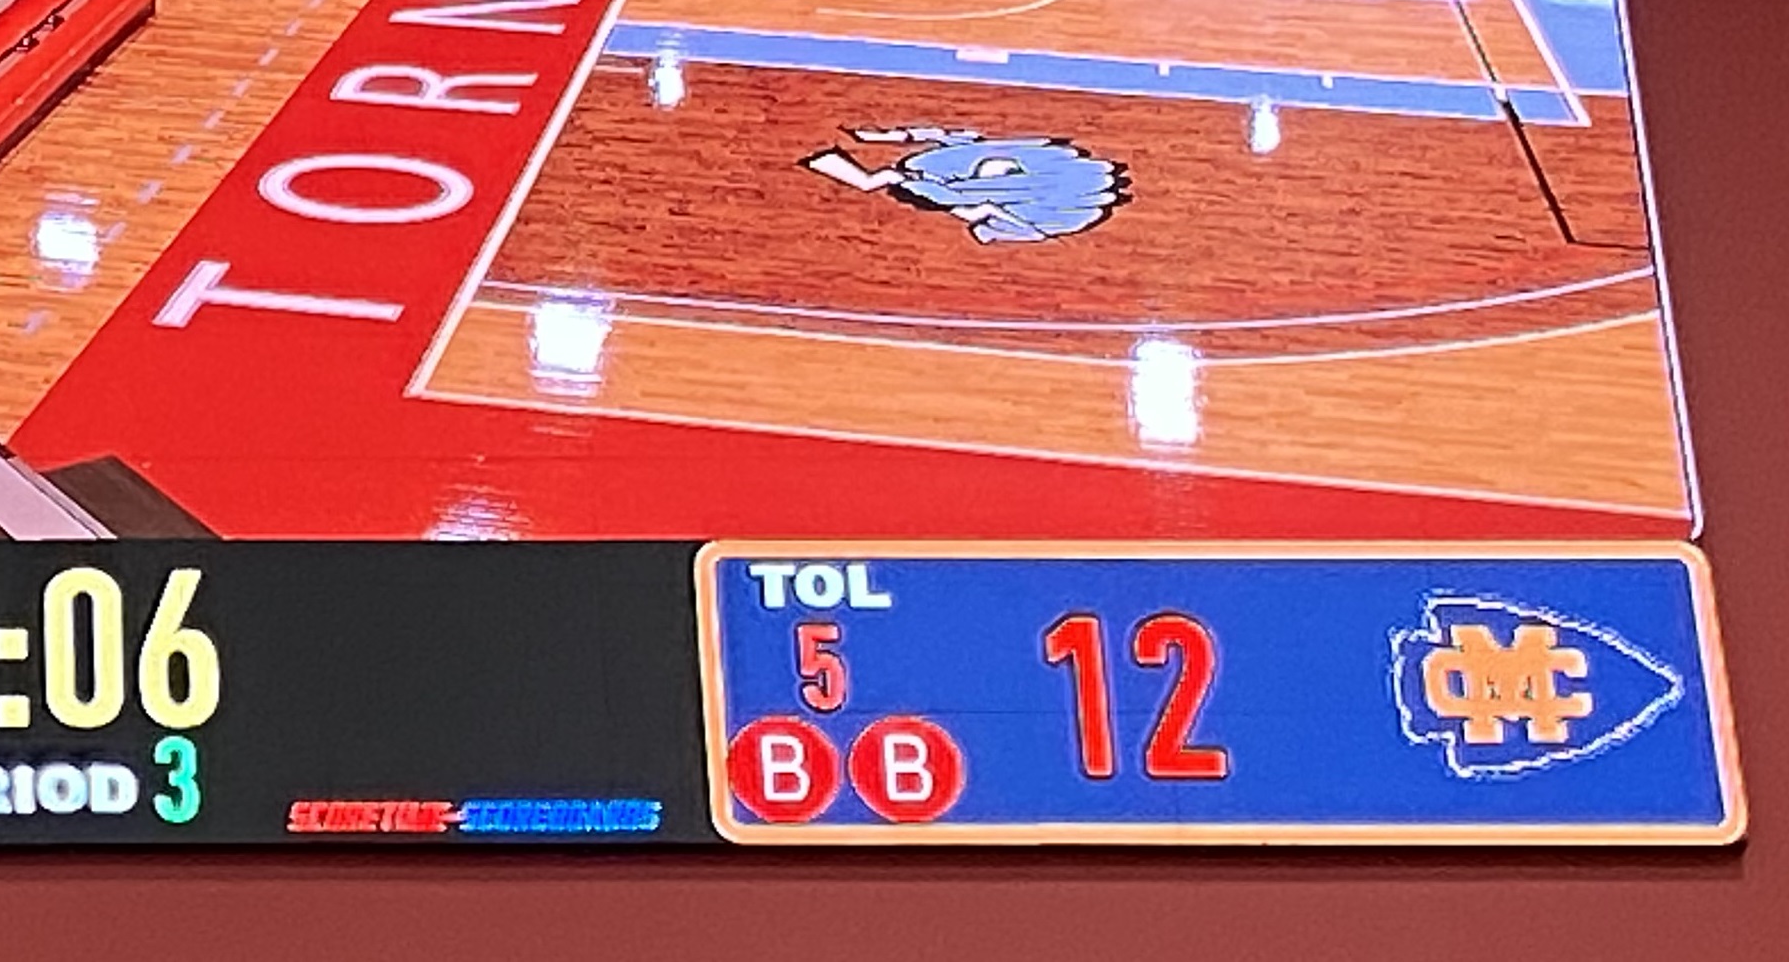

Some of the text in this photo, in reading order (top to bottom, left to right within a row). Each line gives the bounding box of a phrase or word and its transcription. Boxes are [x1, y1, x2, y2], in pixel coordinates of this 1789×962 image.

[750, 564, 892, 609] TOL
[795, 622, 849, 712] 5
[1042, 615, 1230, 779] 12
[151, 735, 201, 824] 3
[760, 735, 934, 803] B B
